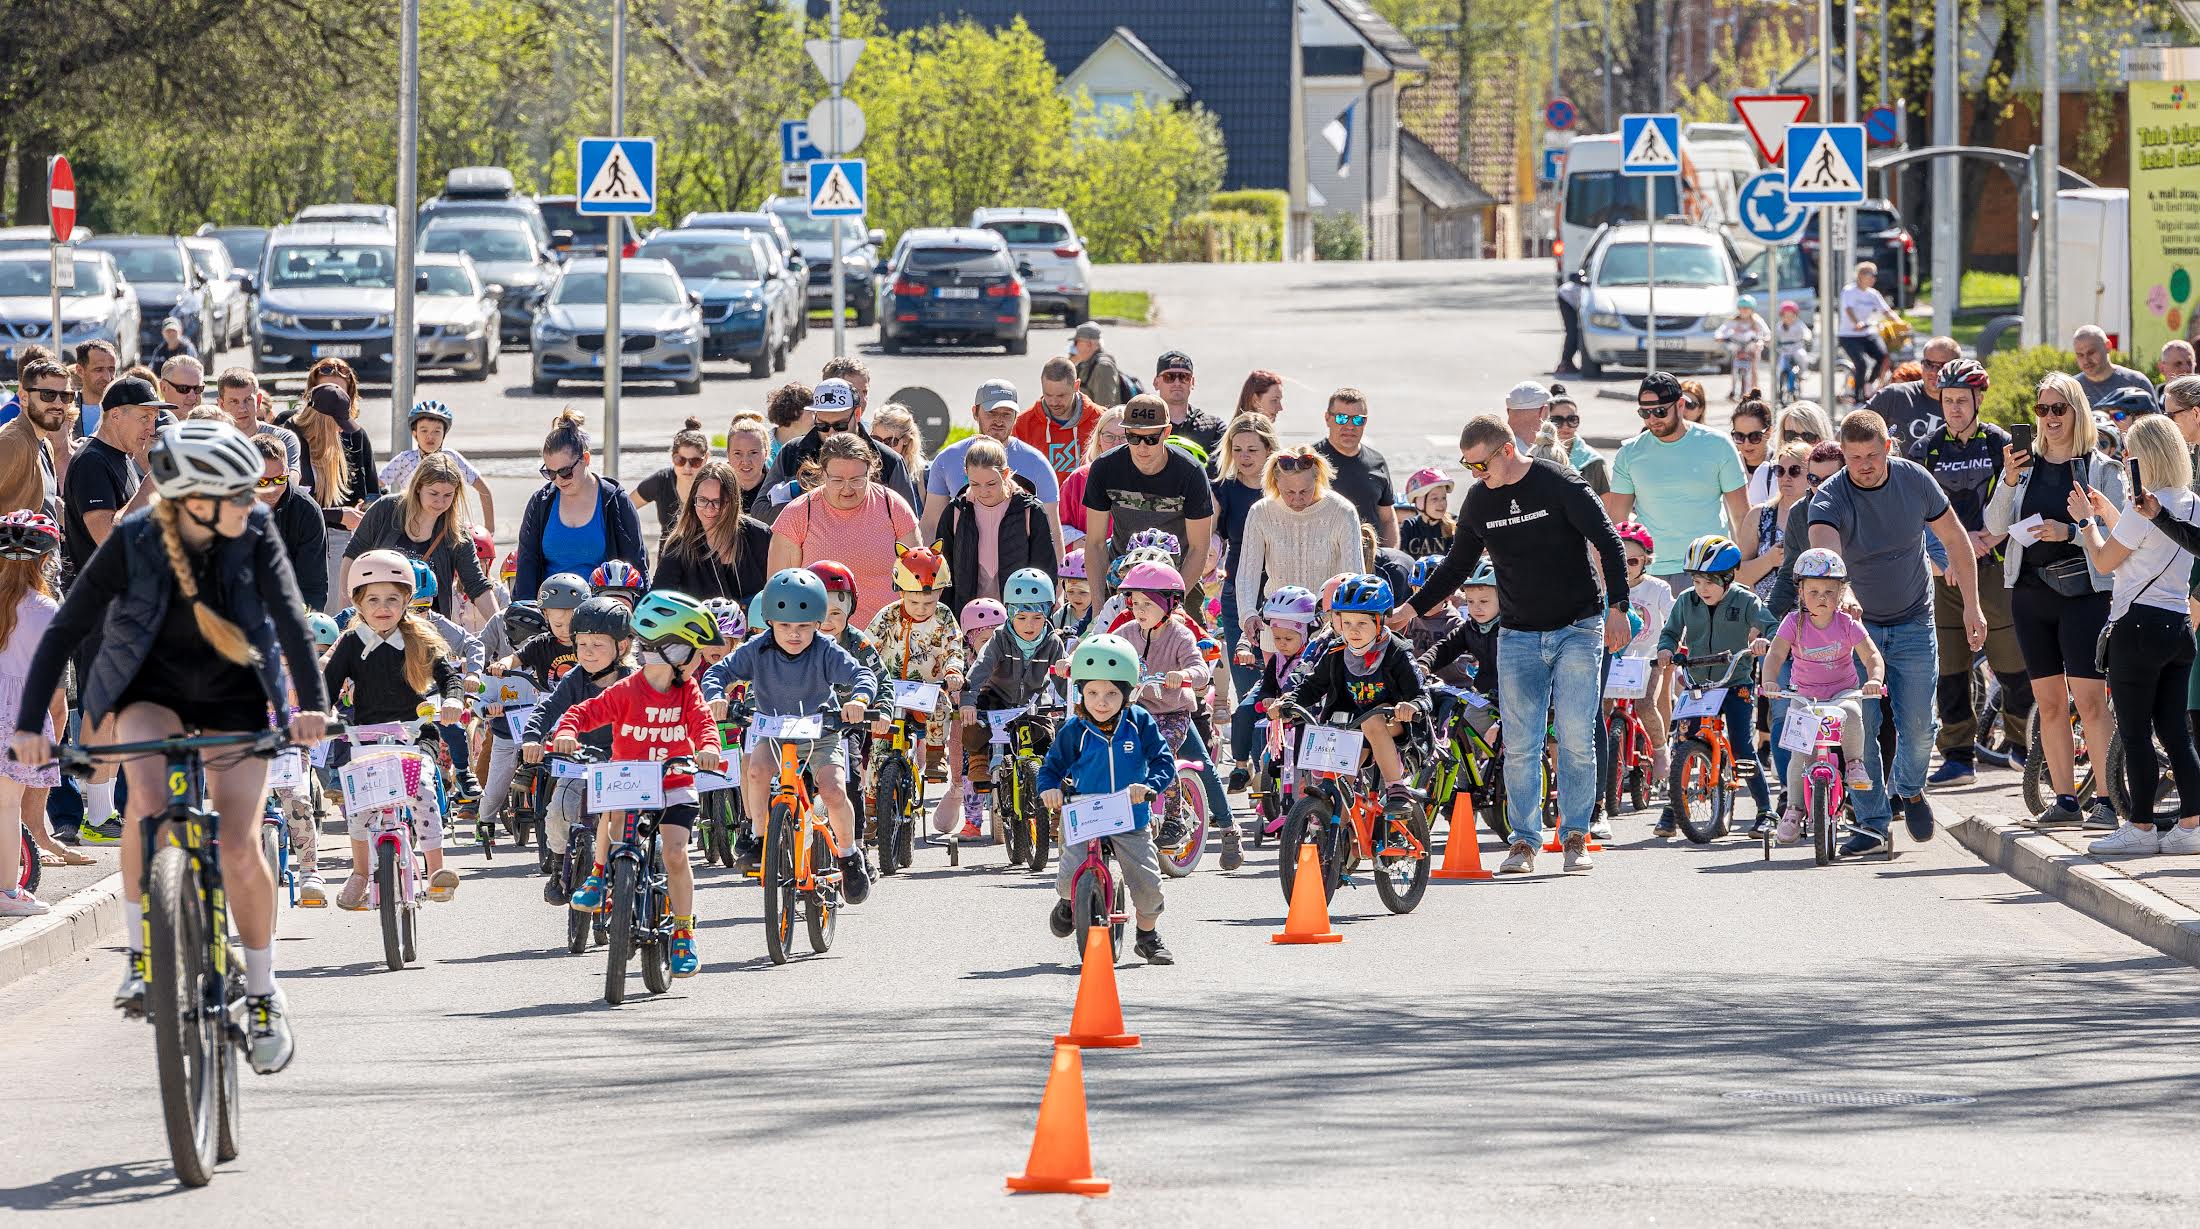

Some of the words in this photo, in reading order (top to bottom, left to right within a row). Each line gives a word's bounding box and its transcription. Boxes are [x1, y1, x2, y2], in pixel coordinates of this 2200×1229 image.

[1486, 518, 1507, 529] ENTER
[1507, 516, 1521, 526] THE
[1408, 537, 1446, 555] GAN
[645, 706, 682, 723] THE
[649, 747, 669, 761] IS
[606, 779, 641, 792] ARON
